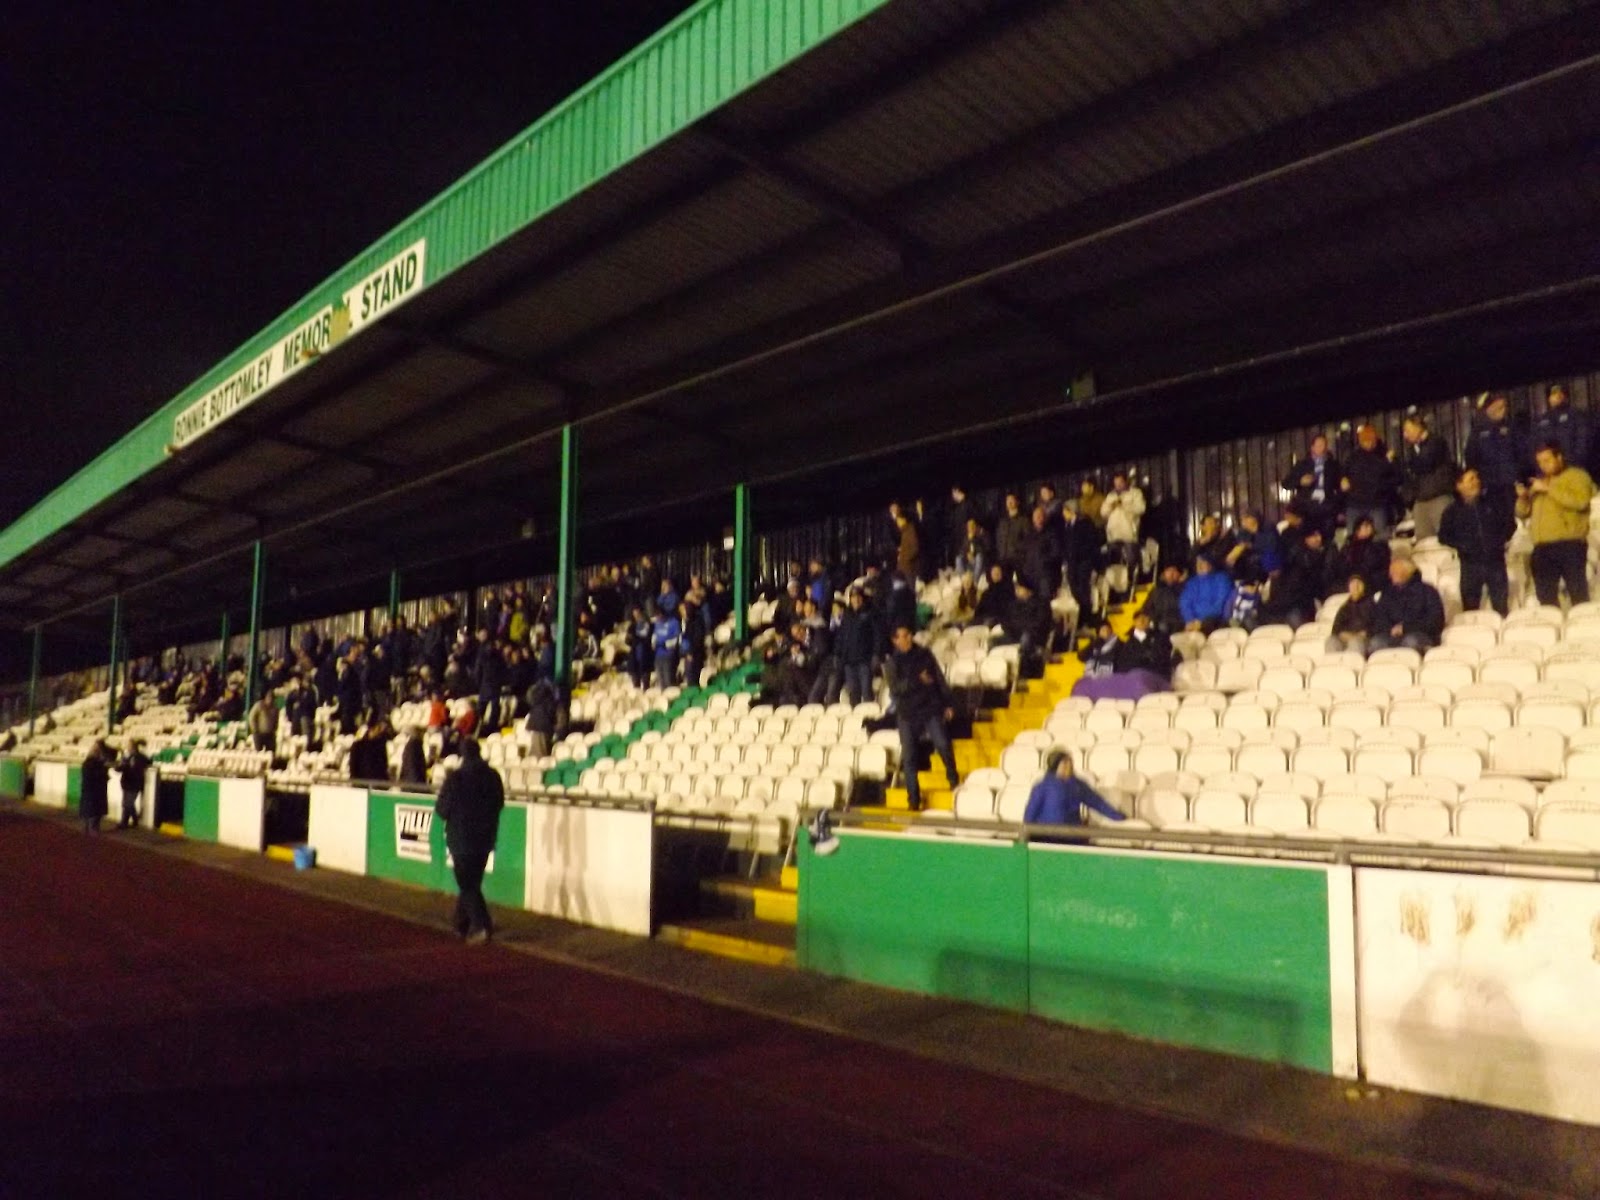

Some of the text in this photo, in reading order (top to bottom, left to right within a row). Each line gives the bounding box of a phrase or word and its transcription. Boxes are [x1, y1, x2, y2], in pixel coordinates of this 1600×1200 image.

[210, 353, 272, 422] BOTTOMLEY
[282, 296, 352, 373] MEMOR
[361, 252, 417, 319] STAND
